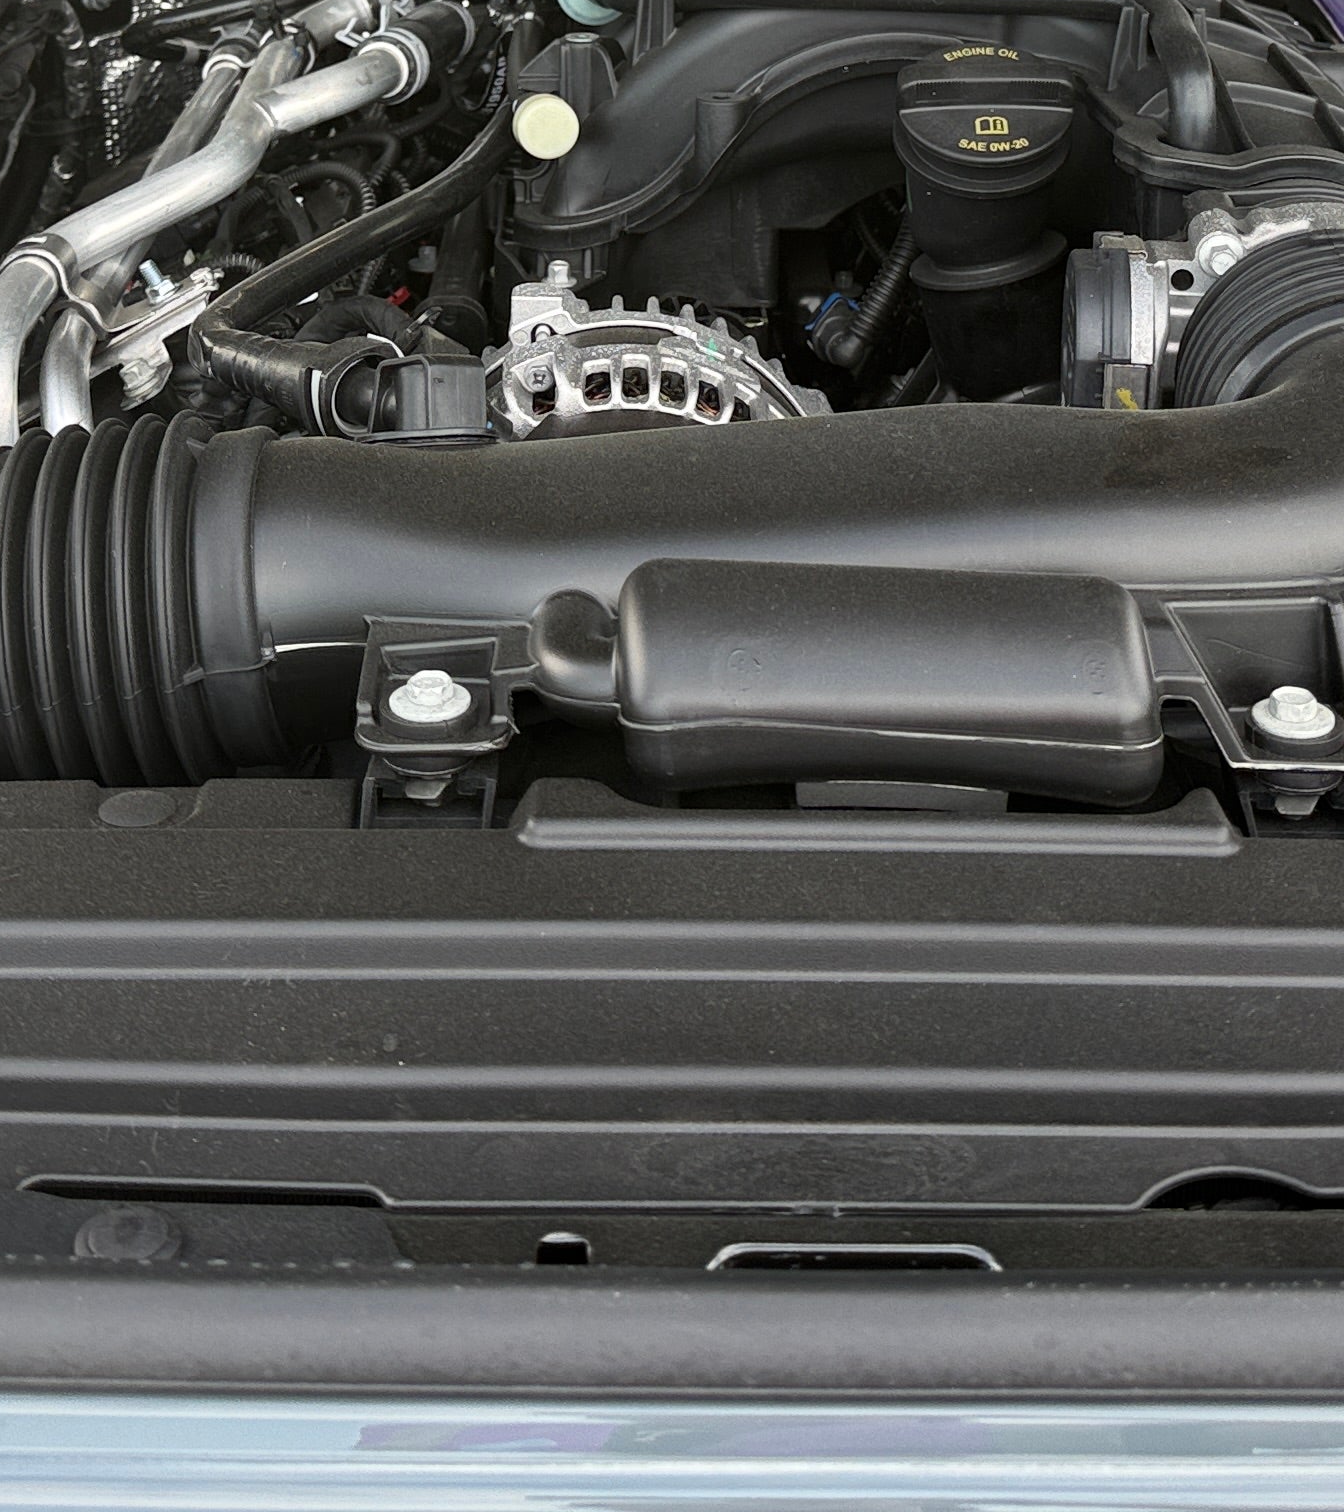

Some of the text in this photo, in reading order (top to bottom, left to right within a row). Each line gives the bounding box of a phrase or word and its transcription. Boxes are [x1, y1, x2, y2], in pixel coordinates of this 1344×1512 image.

[943, 47, 1020, 62] ENGINE OIL
[958, 137, 1030, 152] SAE 0W-20
